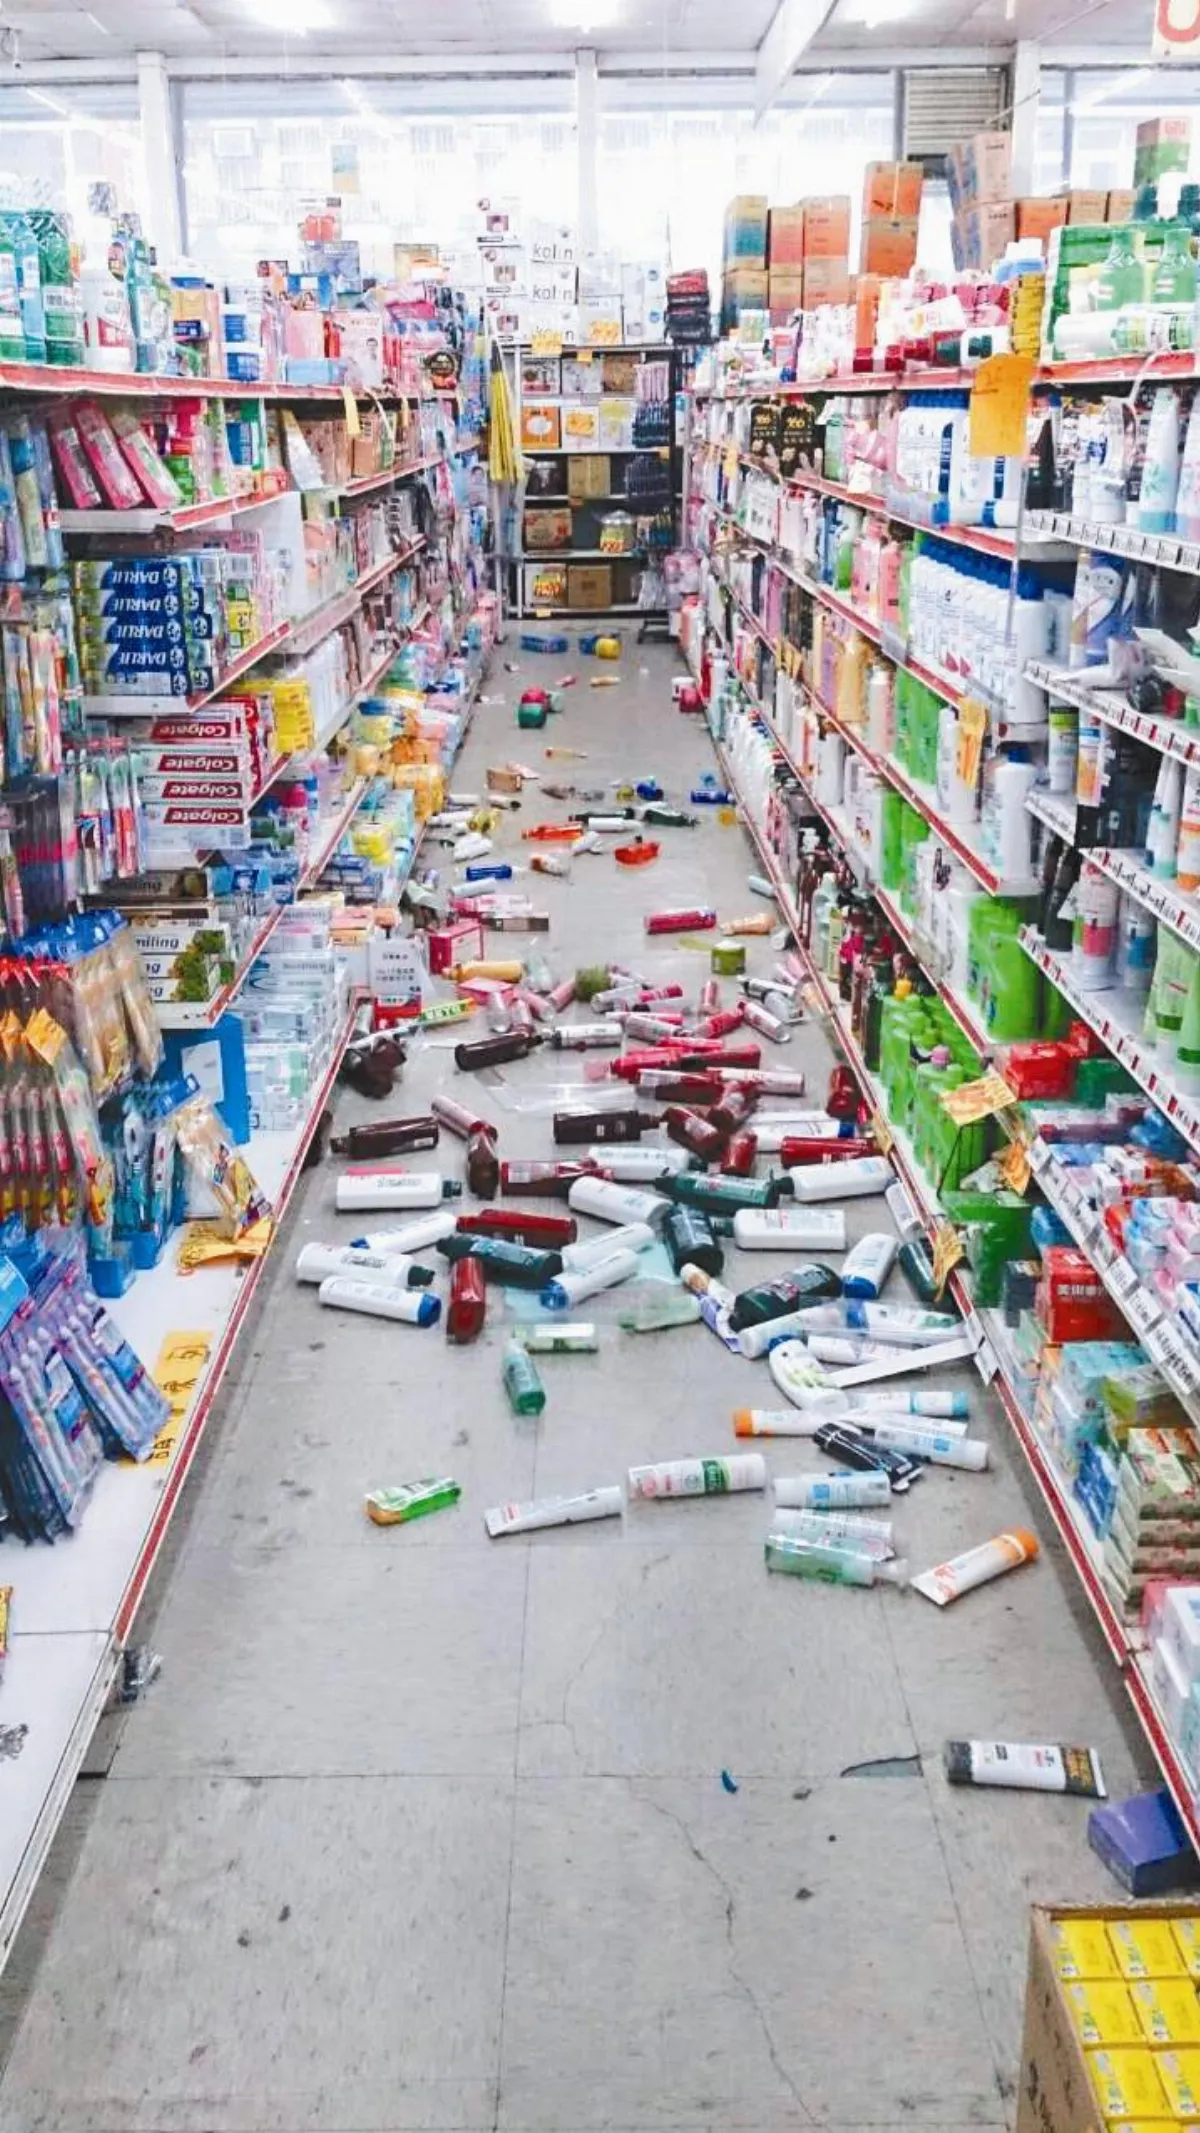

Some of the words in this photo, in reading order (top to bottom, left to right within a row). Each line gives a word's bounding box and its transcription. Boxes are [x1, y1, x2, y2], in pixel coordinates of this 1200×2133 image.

[158, 722, 228, 738] Colgate
[165, 757, 235, 772] Colgate
[169, 783, 239, 798] Colgate
[171, 808, 240, 824] Colgate
